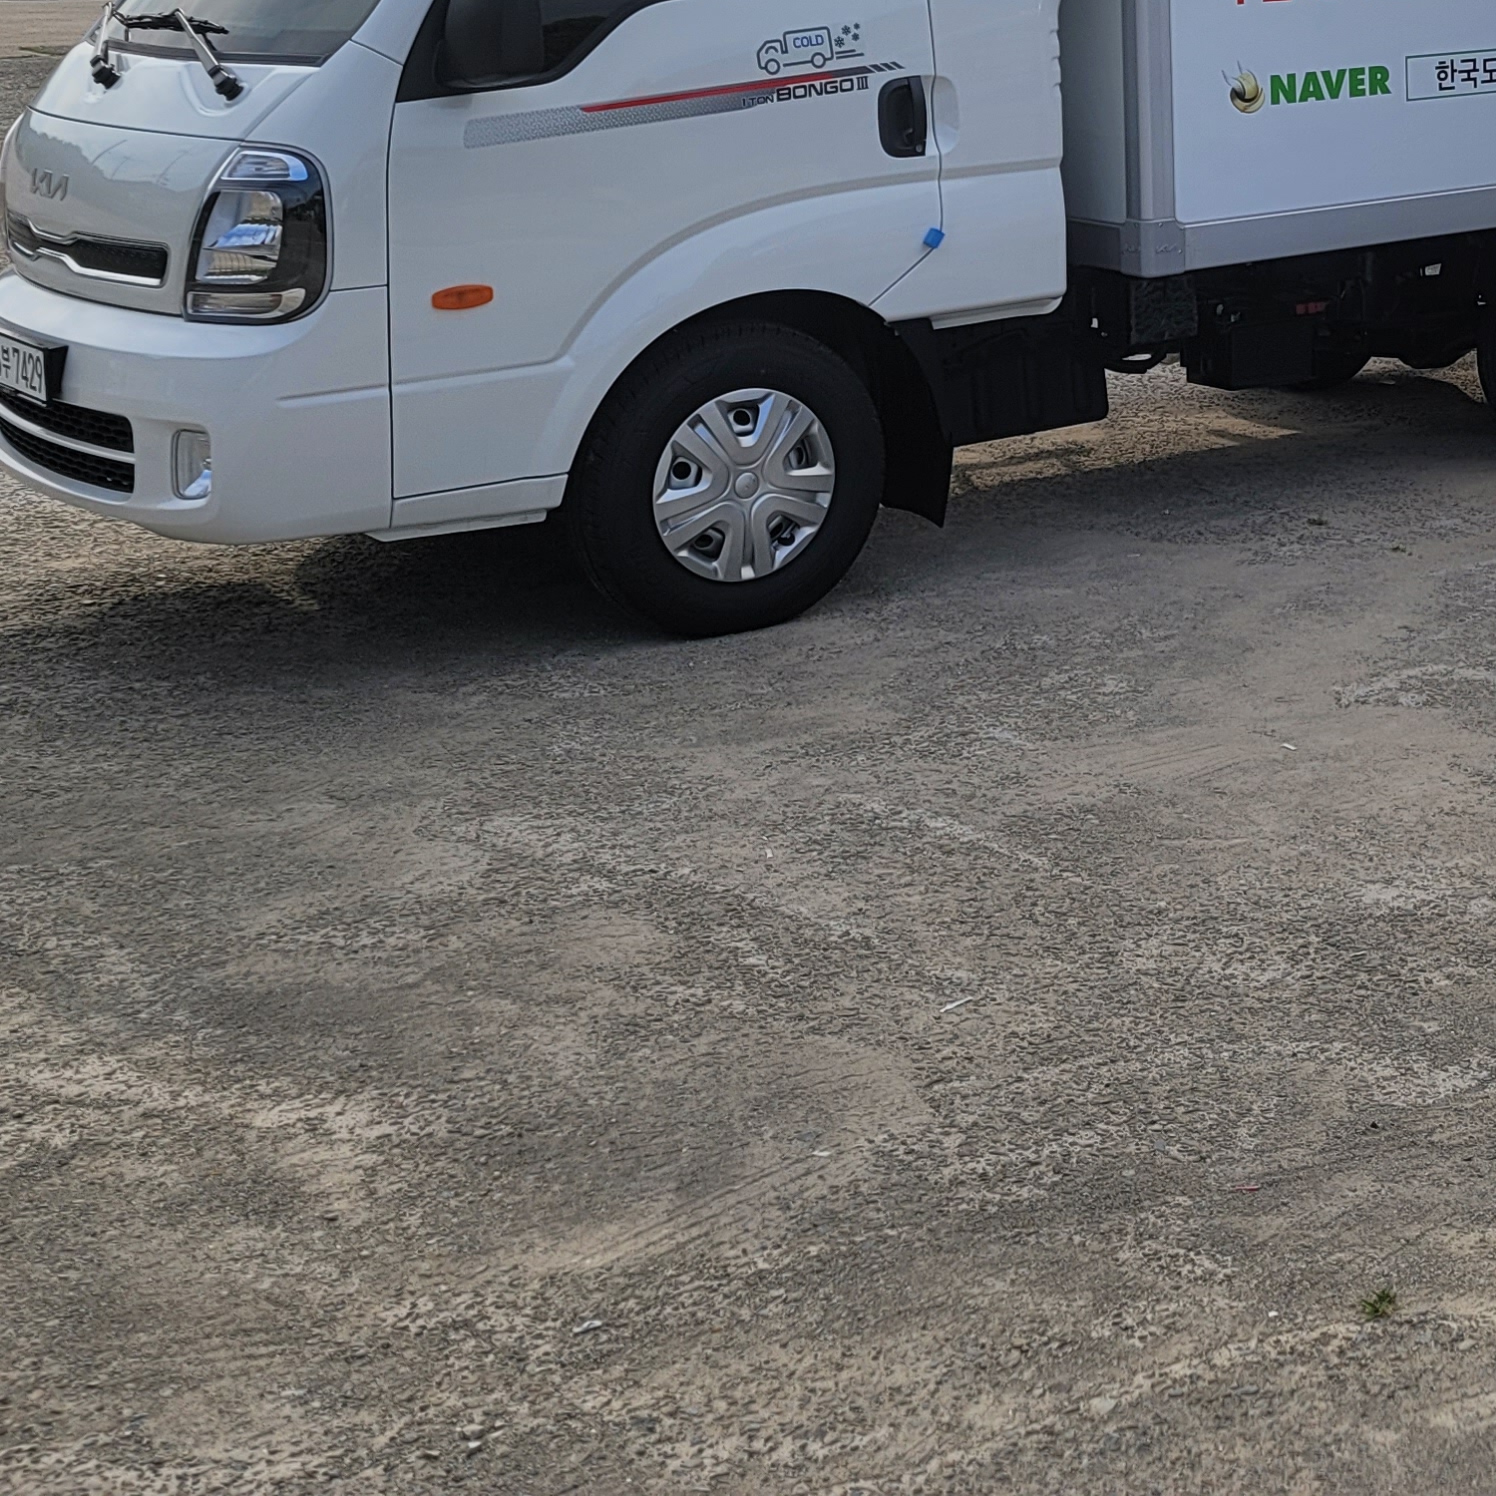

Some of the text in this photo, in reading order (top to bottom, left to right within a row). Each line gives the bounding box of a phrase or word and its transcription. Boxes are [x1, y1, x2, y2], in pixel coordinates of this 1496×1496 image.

[792, 34, 825, 49] COLD
[776, 77, 854, 102] BONGO
[1269, 65, 1392, 106] NAVER
